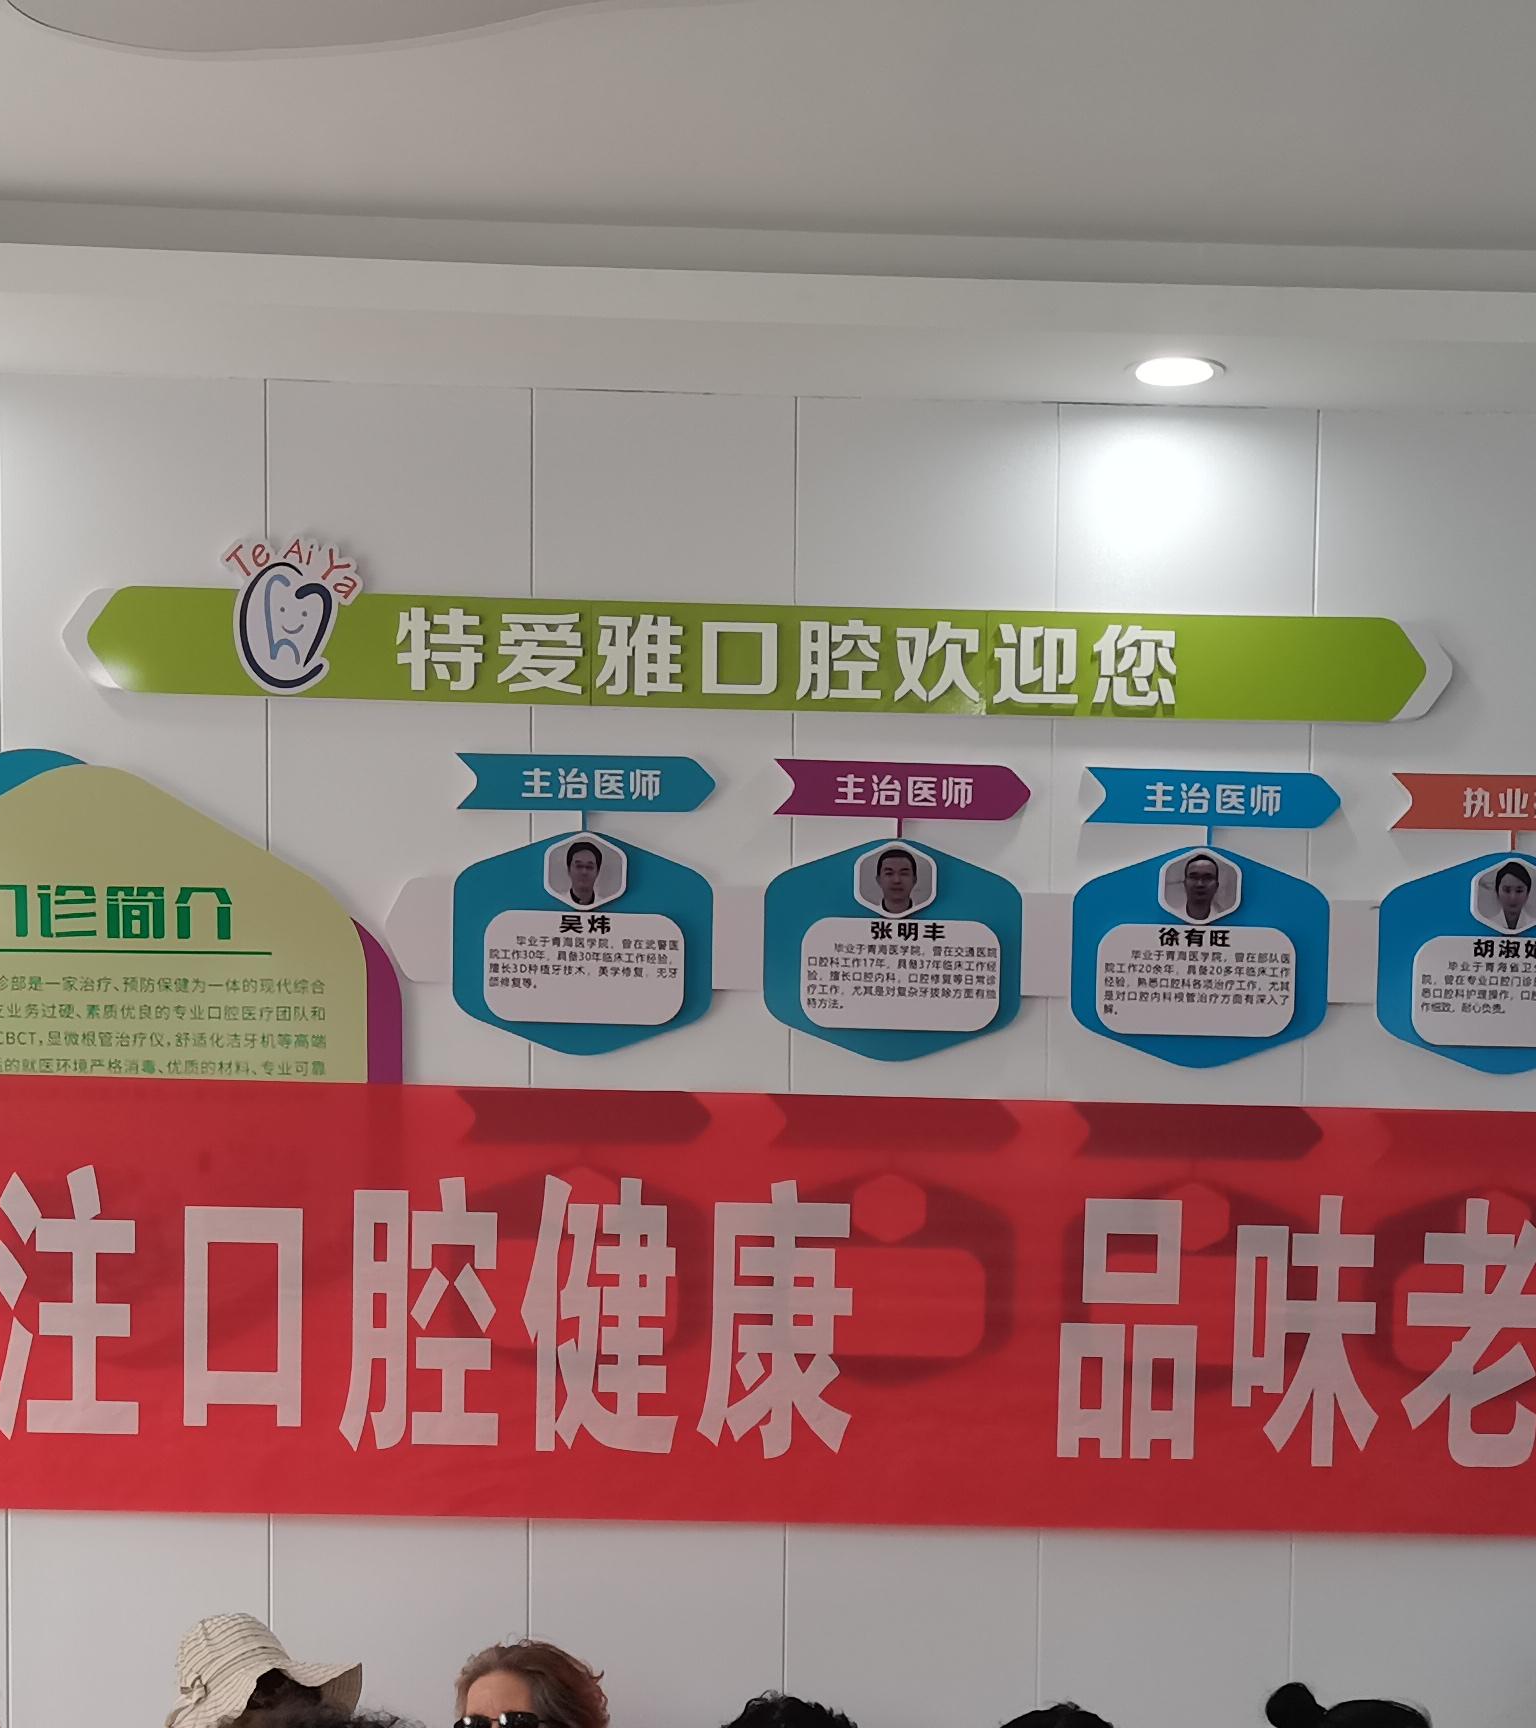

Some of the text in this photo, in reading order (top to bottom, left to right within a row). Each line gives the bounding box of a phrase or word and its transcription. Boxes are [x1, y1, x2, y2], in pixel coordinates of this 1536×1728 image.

[226, 538, 357, 599] Te Ai Ya
[395, 607, 1177, 707] 特爱雅口腔欢迎您
[521, 768, 661, 801] 主治医师
[835, 774, 973, 808] 主治医师
[1144, 782, 1282, 817] 主治医师
[559, 914, 611, 934] 吴炜
[871, 921, 946, 941] 张明丰
[1159, 928, 1231, 948] 徐有旺
